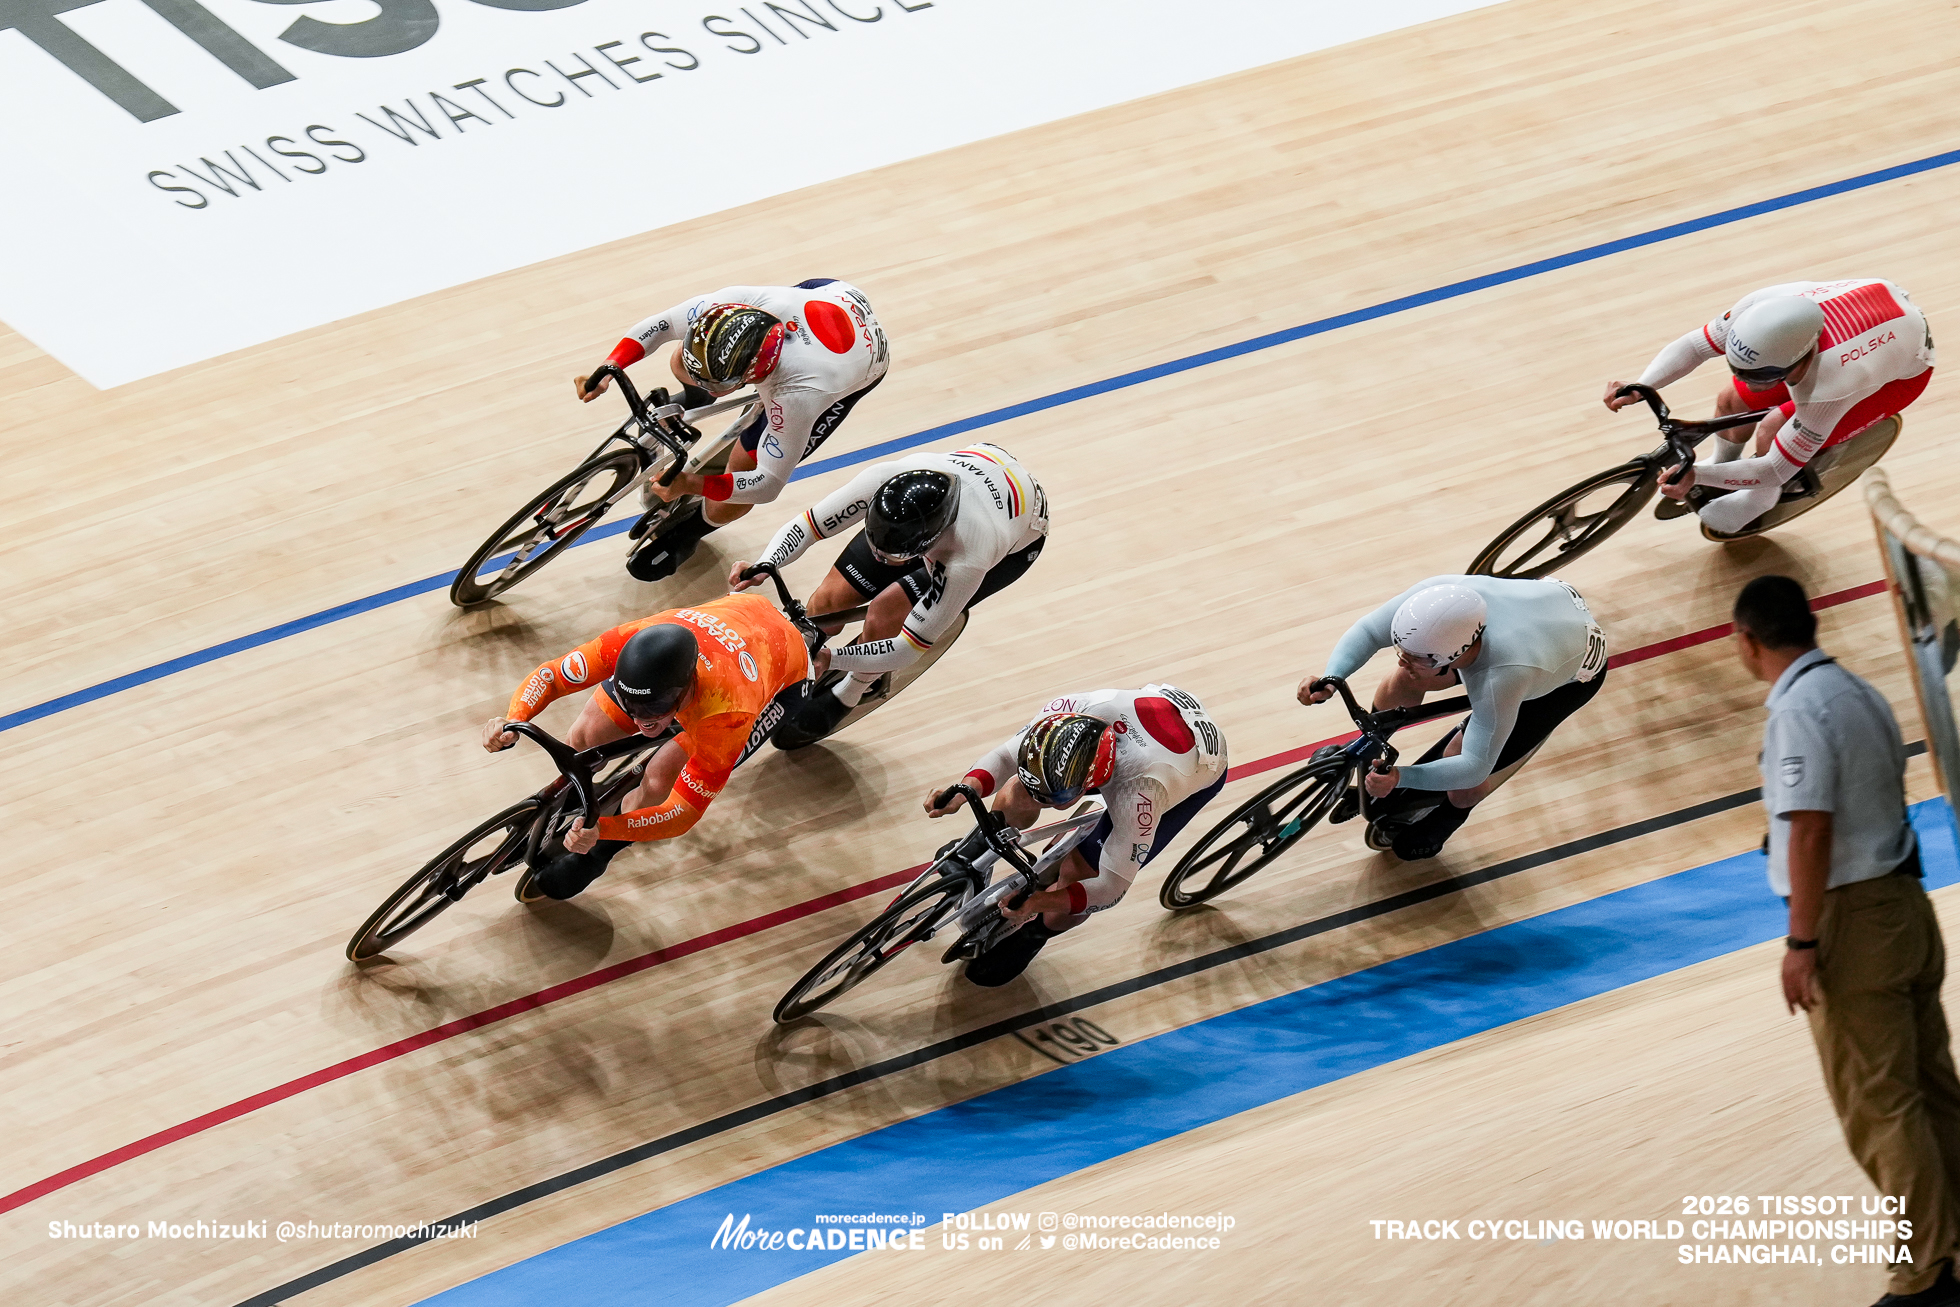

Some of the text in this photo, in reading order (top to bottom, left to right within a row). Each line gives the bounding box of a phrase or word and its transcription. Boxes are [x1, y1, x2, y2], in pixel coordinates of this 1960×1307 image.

[148, 0, 936, 209] SWISS WATCHES SINC
[718, 315, 755, 365] Kabuto
[1840, 331, 1896, 366] POLSKA
[804, 402, 845, 456] JAPAN
[1724, 478, 1761, 486] POLSKA
[823, 499, 869, 531] SKOD
[770, 524, 805, 567] BIORACER
[845, 563, 877, 592] BIORACER
[618, 680, 652, 695] POWERADE
[1055, 722, 1086, 777] Kabuto
[1194, 720, 1219, 757] 168
[627, 803, 685, 829] Rabobank
[1035, 1016, 1119, 1057] 190
